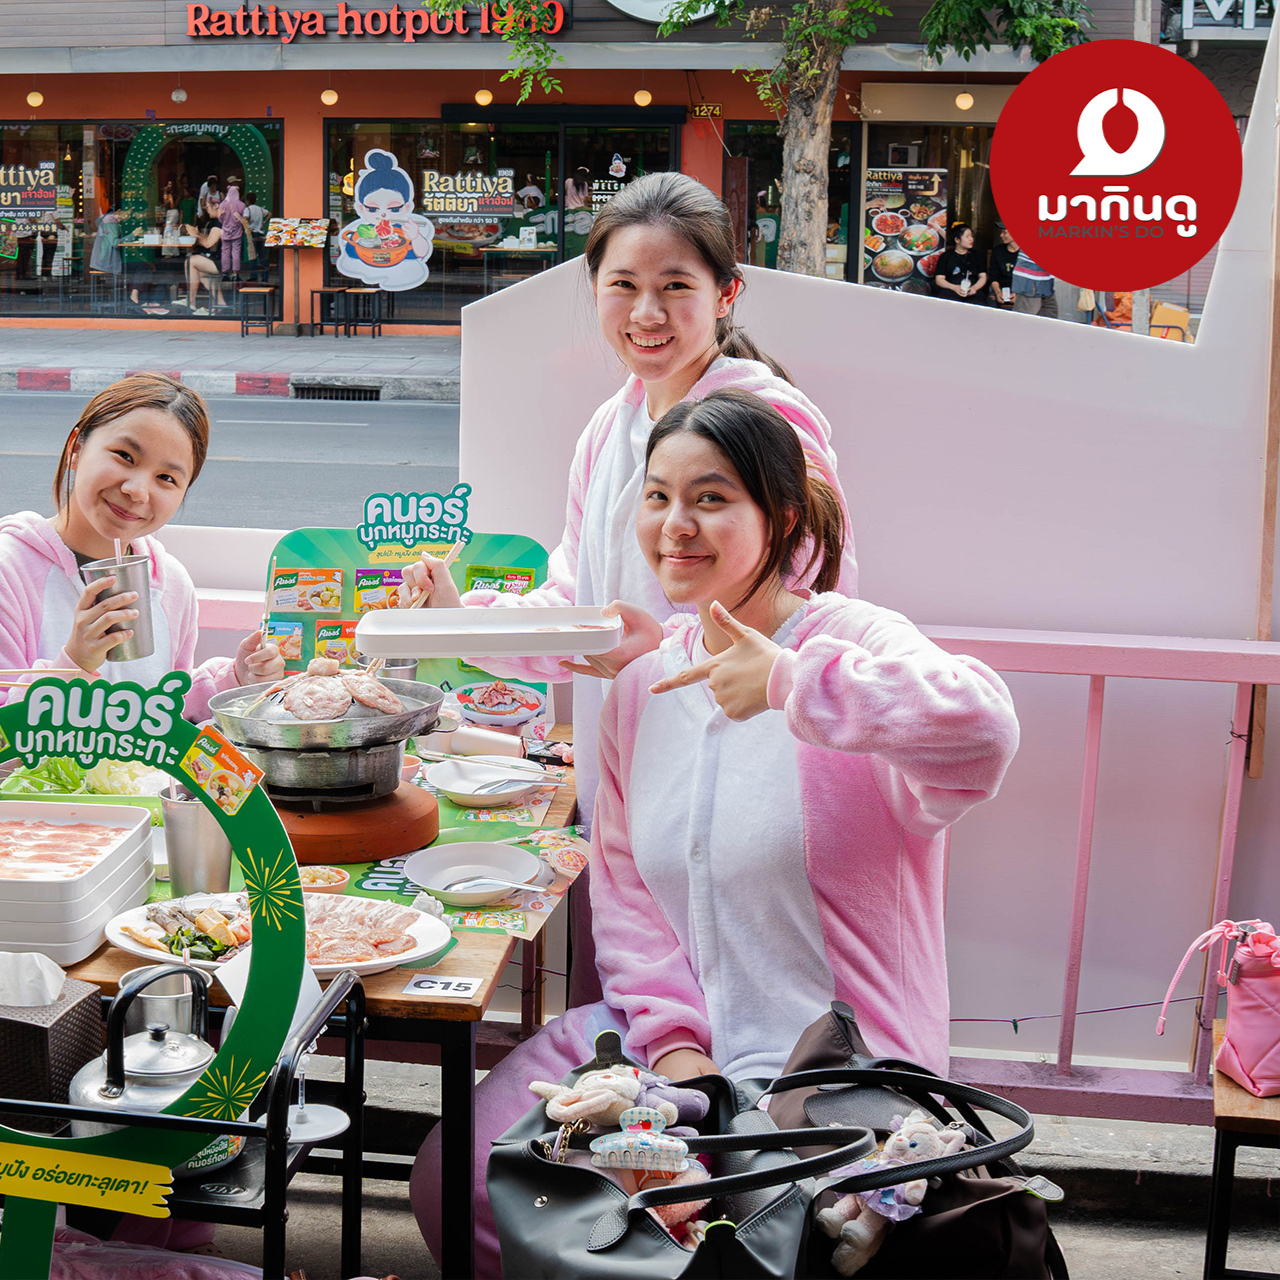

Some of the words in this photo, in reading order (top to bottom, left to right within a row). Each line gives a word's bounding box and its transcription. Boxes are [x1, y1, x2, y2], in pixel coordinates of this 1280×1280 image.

[186, 3, 326, 44] Rattiya
[336, 3, 469, 43] hotpot
[693, 106, 721, 117] 1274
[423, 170, 514, 198] Rattiya
[866, 170, 903, 182] Rattiya
[592, 182, 626, 190] WELCO
[423, 193, 478, 212] รัตติยา
[367, 487, 469, 525] คนอร์
[360, 523, 471, 548] บุกหมูกระทะ
[274, 576, 298, 587] คนอร์
[358, 576, 382, 588] คนอร์
[318, 626, 341, 639] คนอร์
[26, 678, 183, 737] คนอร์
[15, 729, 180, 766] บุกหมูกระทะ
[196, 737, 219, 755] คนอร์
[413, 978, 474, 993] C15
[187, 1151, 228, 1169] คนอร์ก้อน
[32, 1164, 150, 1197] อร่อยทะลุเตา!
